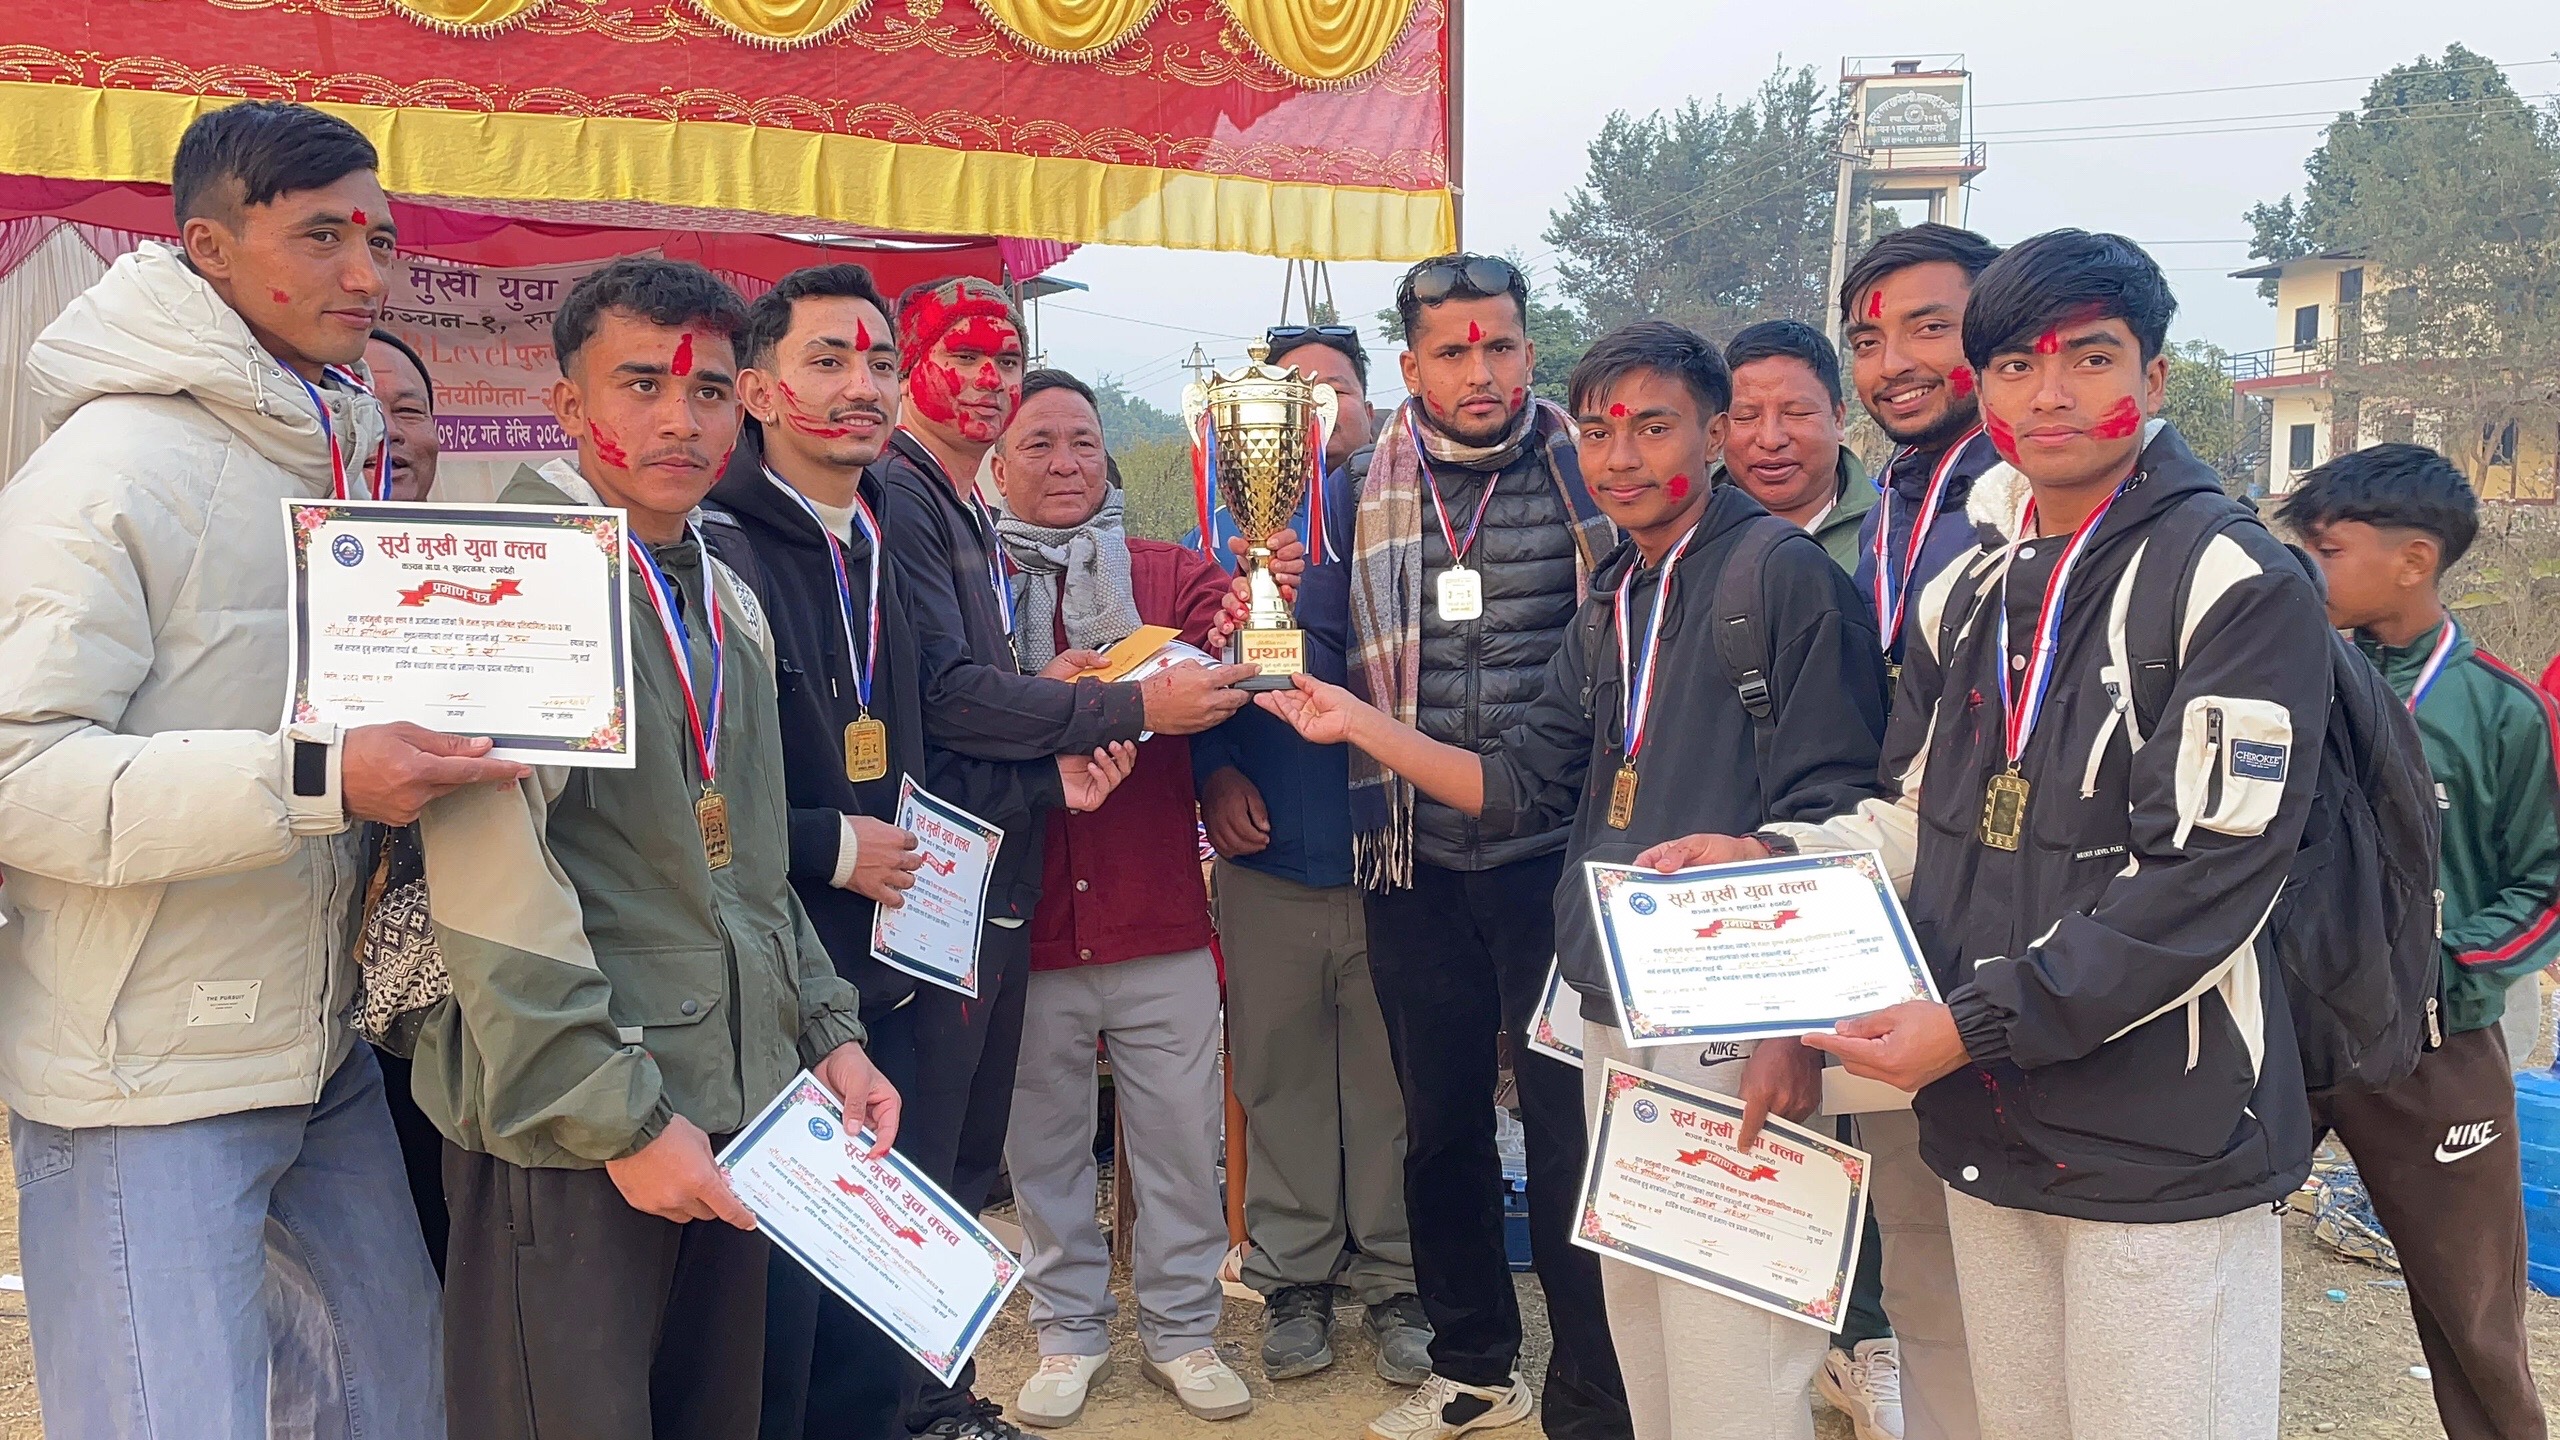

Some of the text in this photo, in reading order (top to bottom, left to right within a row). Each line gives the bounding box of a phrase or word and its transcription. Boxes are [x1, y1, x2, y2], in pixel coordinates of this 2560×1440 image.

[409, 266, 559, 312] मुखी युवा
[480, 419, 501, 446] गते
[505, 418, 532, 447] देखि
[377, 532, 410, 559] सूर्य
[416, 533, 457, 561] मुखी
[464, 539, 498, 562] युवा
[504, 540, 547, 560] क्लव
[432, 582, 492, 605] प्रमाण-पत्र
[1248, 647, 1298, 661] प्रथम
[1667, 879, 1818, 908] सूर्य मुखी युवा क्लव
[1708, 1041, 1740, 1057] NIKE
[1670, 1108, 1697, 1128] सूर्य
[1700, 1118, 1735, 1139] मुखी
[1770, 1141, 1804, 1165] क्लव
[2444, 1119, 2494, 1146] NIKE
[1706, 1153, 1752, 1180] प्रमाण-पत्र
[869, 1161, 902, 1193] मुखी
[901, 1190, 928, 1217] युवा
[927, 1213, 961, 1247] क्लव
